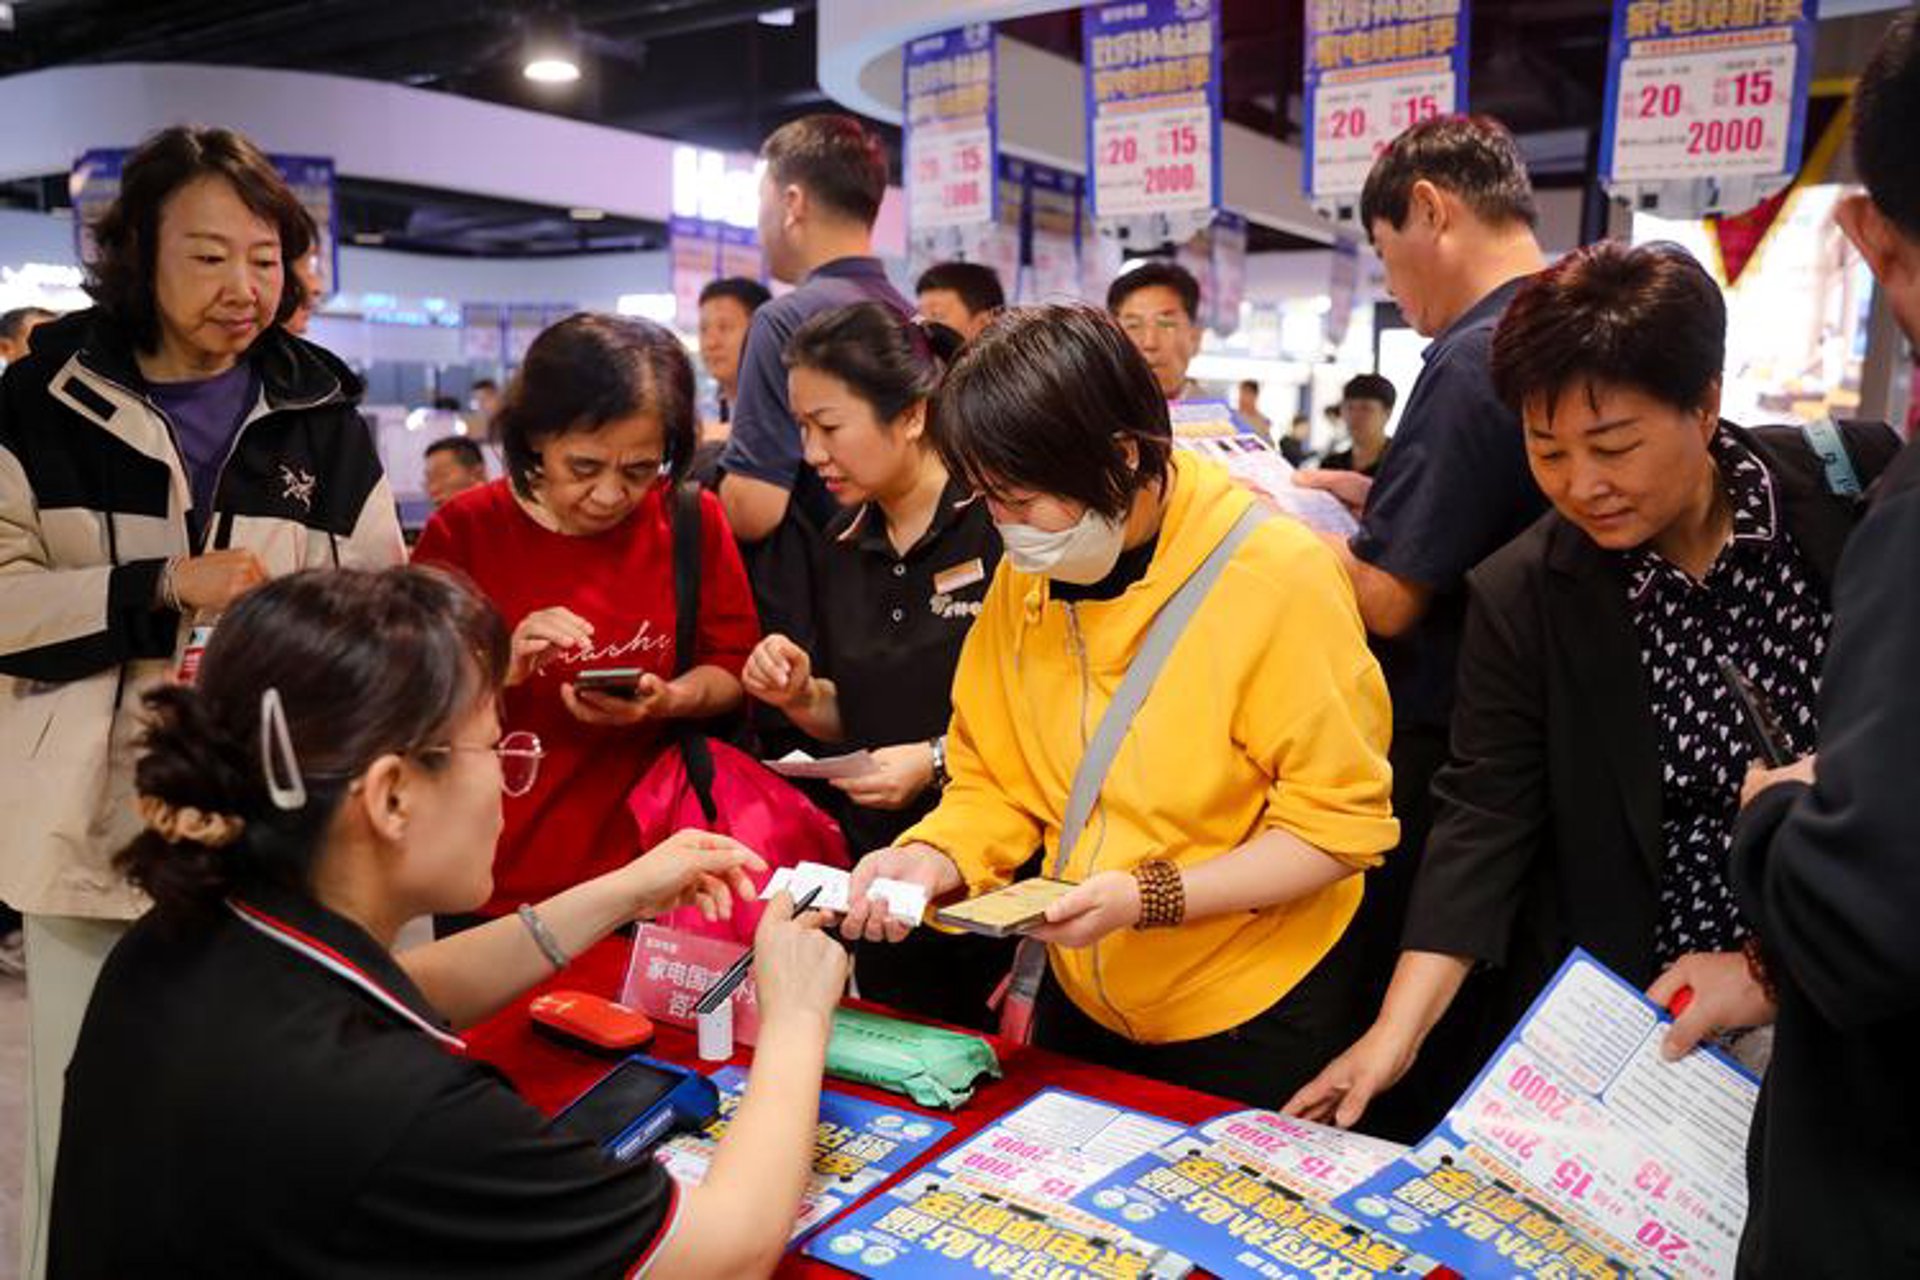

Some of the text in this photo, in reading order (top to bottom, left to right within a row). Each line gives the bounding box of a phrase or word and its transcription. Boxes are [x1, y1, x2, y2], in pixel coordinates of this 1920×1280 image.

[1639, 83, 1683, 119] 20
[1733, 69, 1773, 107] 15
[1687, 116, 1764, 155] 2000
[1636, 1221, 1689, 1261] 20
